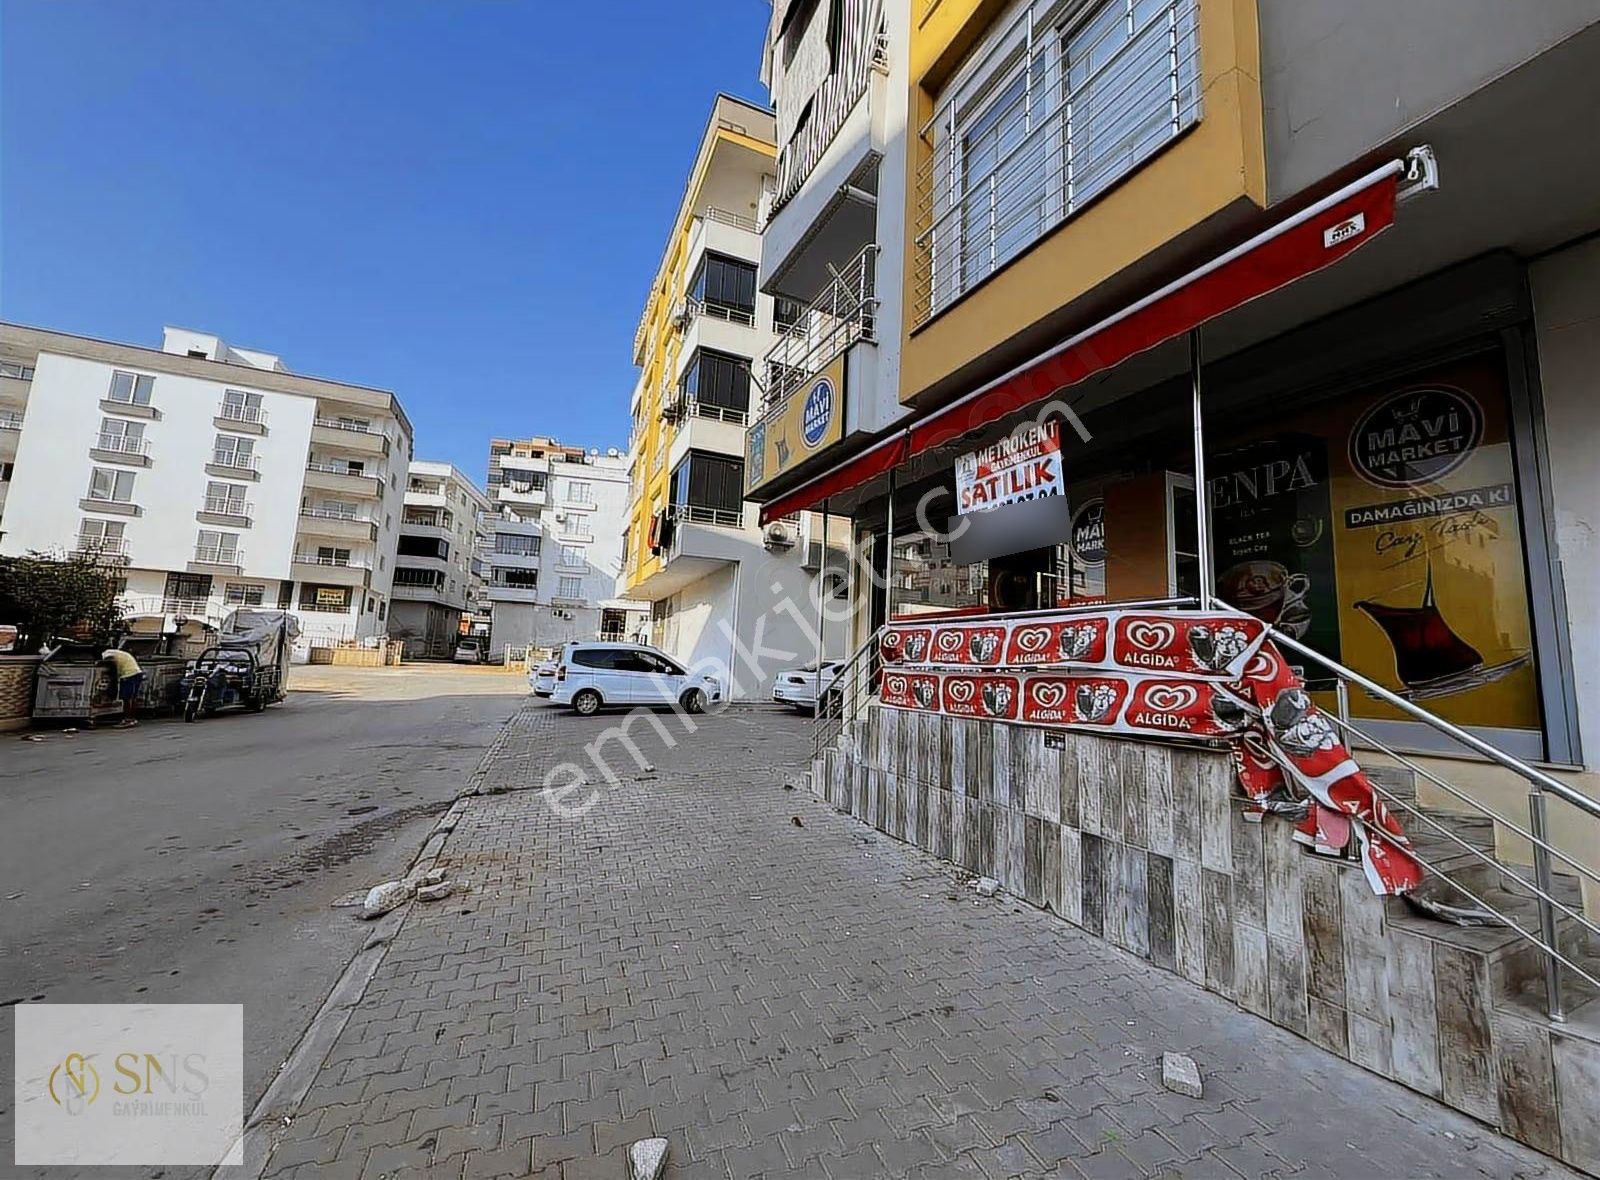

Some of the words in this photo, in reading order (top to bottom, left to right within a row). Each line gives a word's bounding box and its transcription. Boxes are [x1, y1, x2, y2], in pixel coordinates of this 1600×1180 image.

[977, 419, 1057, 464] METROKENT
[1369, 436, 1464, 468] MARKET
[961, 458, 1056, 509] SATILIK
[1205, 454, 1319, 509] ENPA
[1351, 493, 1484, 524] DAMAĞINIZDA
